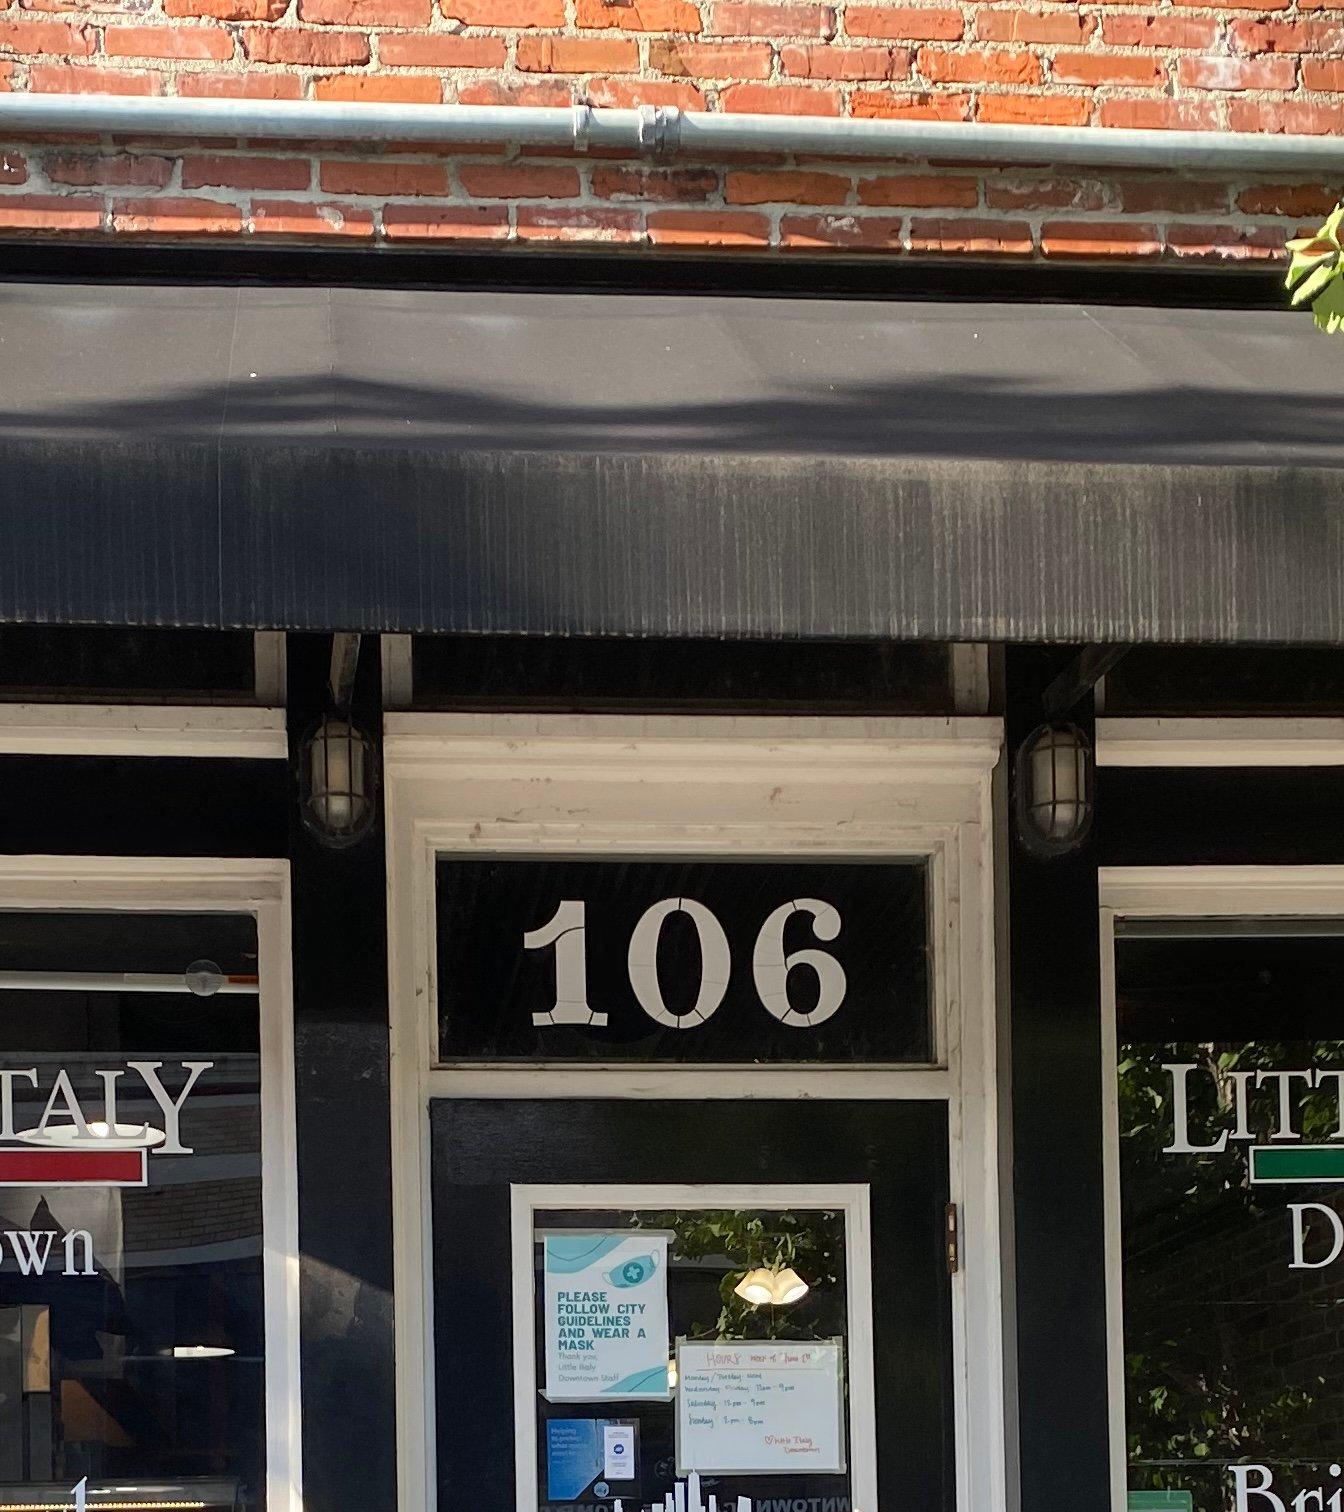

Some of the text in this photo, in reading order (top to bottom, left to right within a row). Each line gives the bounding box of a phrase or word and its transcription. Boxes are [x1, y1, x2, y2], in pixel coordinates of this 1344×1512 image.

[524, 896, 847, 1030] 106
[557, 1292, 608, 1303] PLEASE
[557, 1304, 646, 1315] FOLLOW CITY
[557, 1316, 631, 1327] GUIDELINES
[558, 1328, 646, 1339] AND WEAR A
[558, 1340, 595, 1351] MASK
